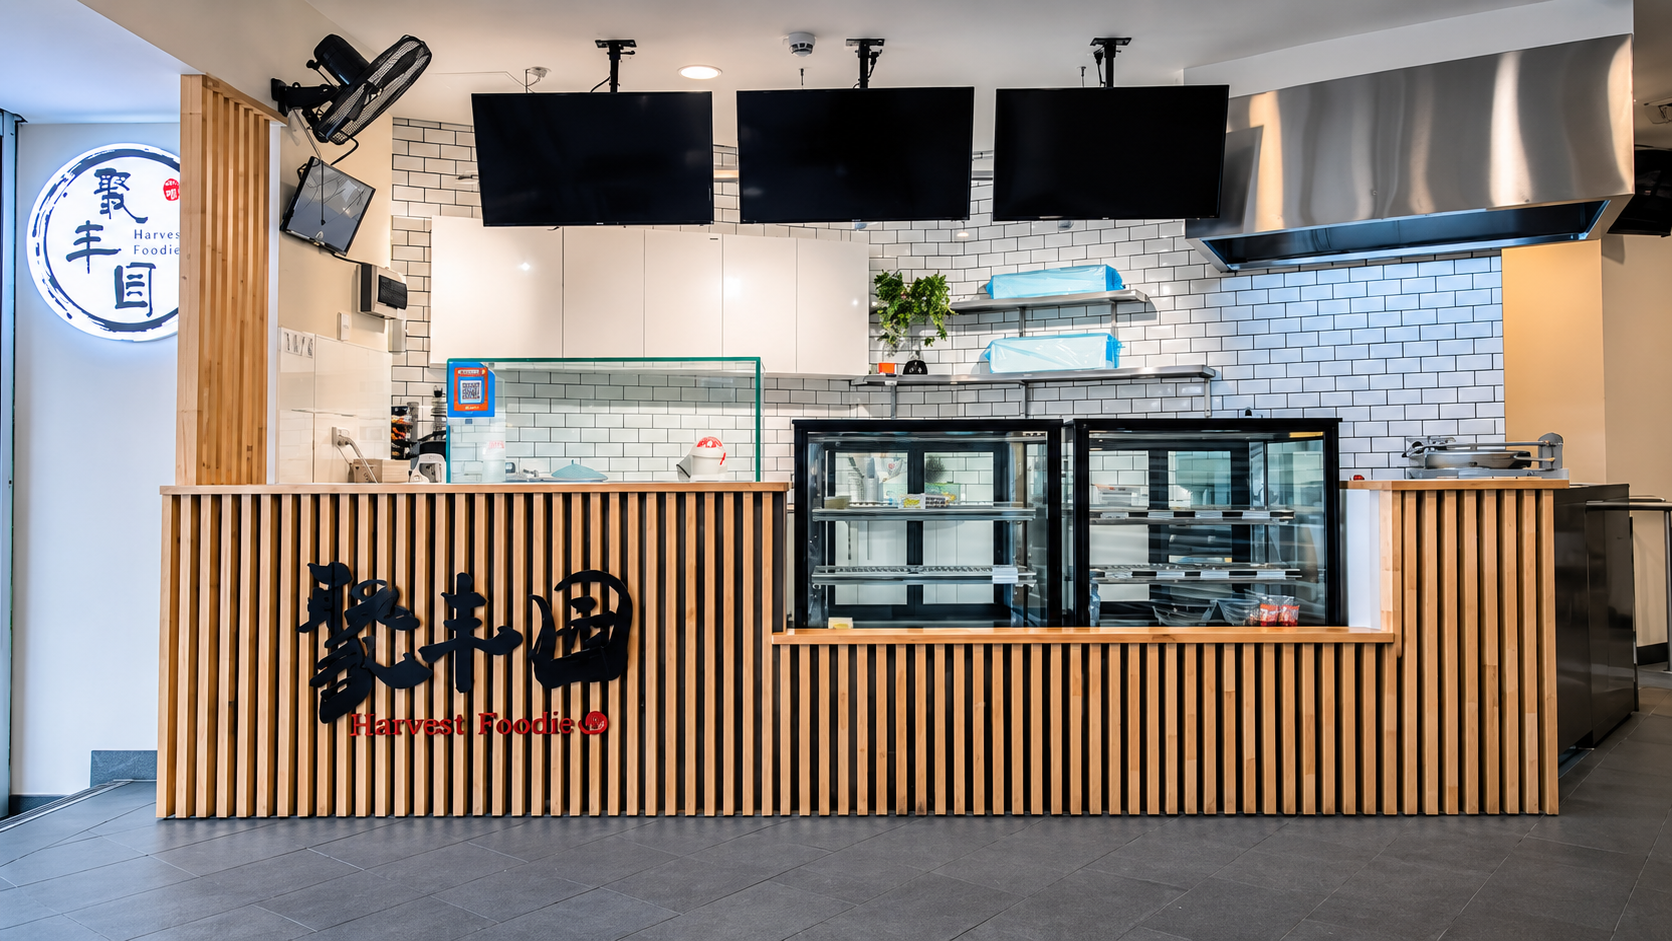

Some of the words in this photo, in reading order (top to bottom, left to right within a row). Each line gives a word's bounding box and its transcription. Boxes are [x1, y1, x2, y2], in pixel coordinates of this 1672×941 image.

[134, 229, 180, 240] Harves
[134, 244, 180, 255] Foodie
[350, 713, 466, 737] Harvest
[478, 711, 575, 736] Foodie
